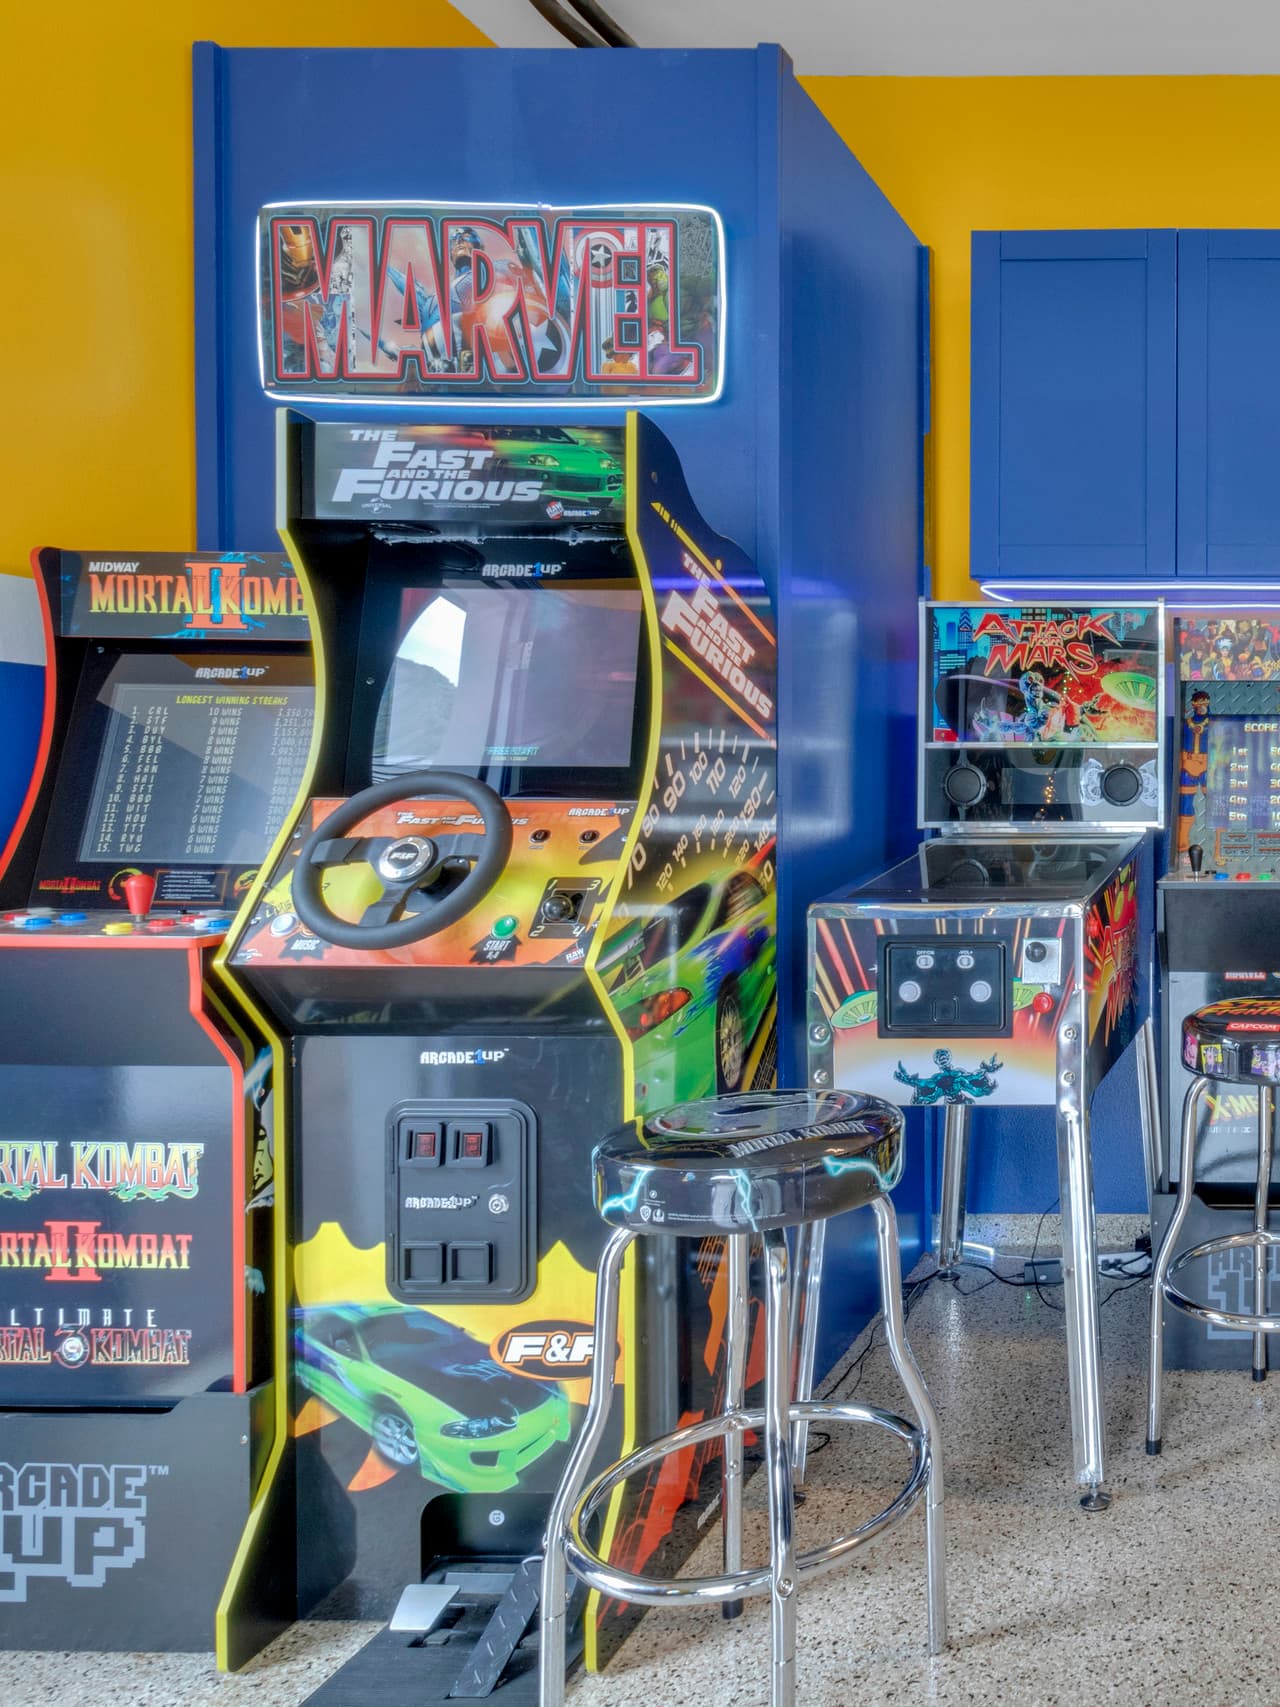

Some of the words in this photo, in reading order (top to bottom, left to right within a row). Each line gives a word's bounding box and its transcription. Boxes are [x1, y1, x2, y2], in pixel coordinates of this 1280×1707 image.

[271, 215, 704, 384] MARVEL
[350, 429, 399, 441] THE
[372, 441, 497, 469] FAST
[385, 470, 428, 479] AND
[433, 470, 471, 479] THE
[331, 468, 544, 502] FURIOUS
[89, 562, 139, 572] MIDWAY
[683, 552, 711, 587] THE
[89, 575, 213, 614] MORTAL
[691, 585, 757, 664] FAST
[972, 612, 1122, 648] ATTACK
[1030, 634, 1064, 648] from
[661, 589, 774, 719] FURIOUS
[983, 641, 1100, 684] MARS
[176, 695, 212, 704] LONGEST
[215, 696, 250, 705] WINNING
[251, 696, 288, 705] STREAKS
[221, 707, 243, 716] WINS
[220, 717, 241, 726] WINS
[218, 726, 240, 736] WINS
[1244, 723, 1278, 733] SCORE
[216, 736, 237, 745] WINS
[213, 746, 235, 754] WINS
[211, 756, 233, 764] WINS
[210, 765, 231, 774] WINS
[689, 751, 708, 785] 100
[208, 775, 230, 784] WINS
[706, 757, 726, 795] 110
[729, 765, 746, 799] 120
[206, 784, 228, 794] WINS
[663, 770, 686, 814] 90
[204, 794, 225, 804] WINS
[202, 804, 223, 813] WINS
[740, 786, 761, 828] 130
[200, 814, 222, 823] WINS
[642, 803, 660, 838] 80
[198, 824, 220, 833] WINS
[196, 834, 217, 844] WINS
[194, 844, 215, 854] WINS
[672, 834, 688, 862] 140
[655, 863, 673, 892] 120
[547, 879, 558, 890] 1
[587, 880, 601, 891] 3
[529, 926, 545, 937] 2
[572, 926, 585, 937] 4
[483, 940, 511, 951] START
[1230, 1022, 1278, 1031] CAPCOM
[71, 1141, 204, 1189] KOMBAT
[75, 1233, 192, 1269] KOMBAT
[91, 1329, 192, 1364] KOMBAT
